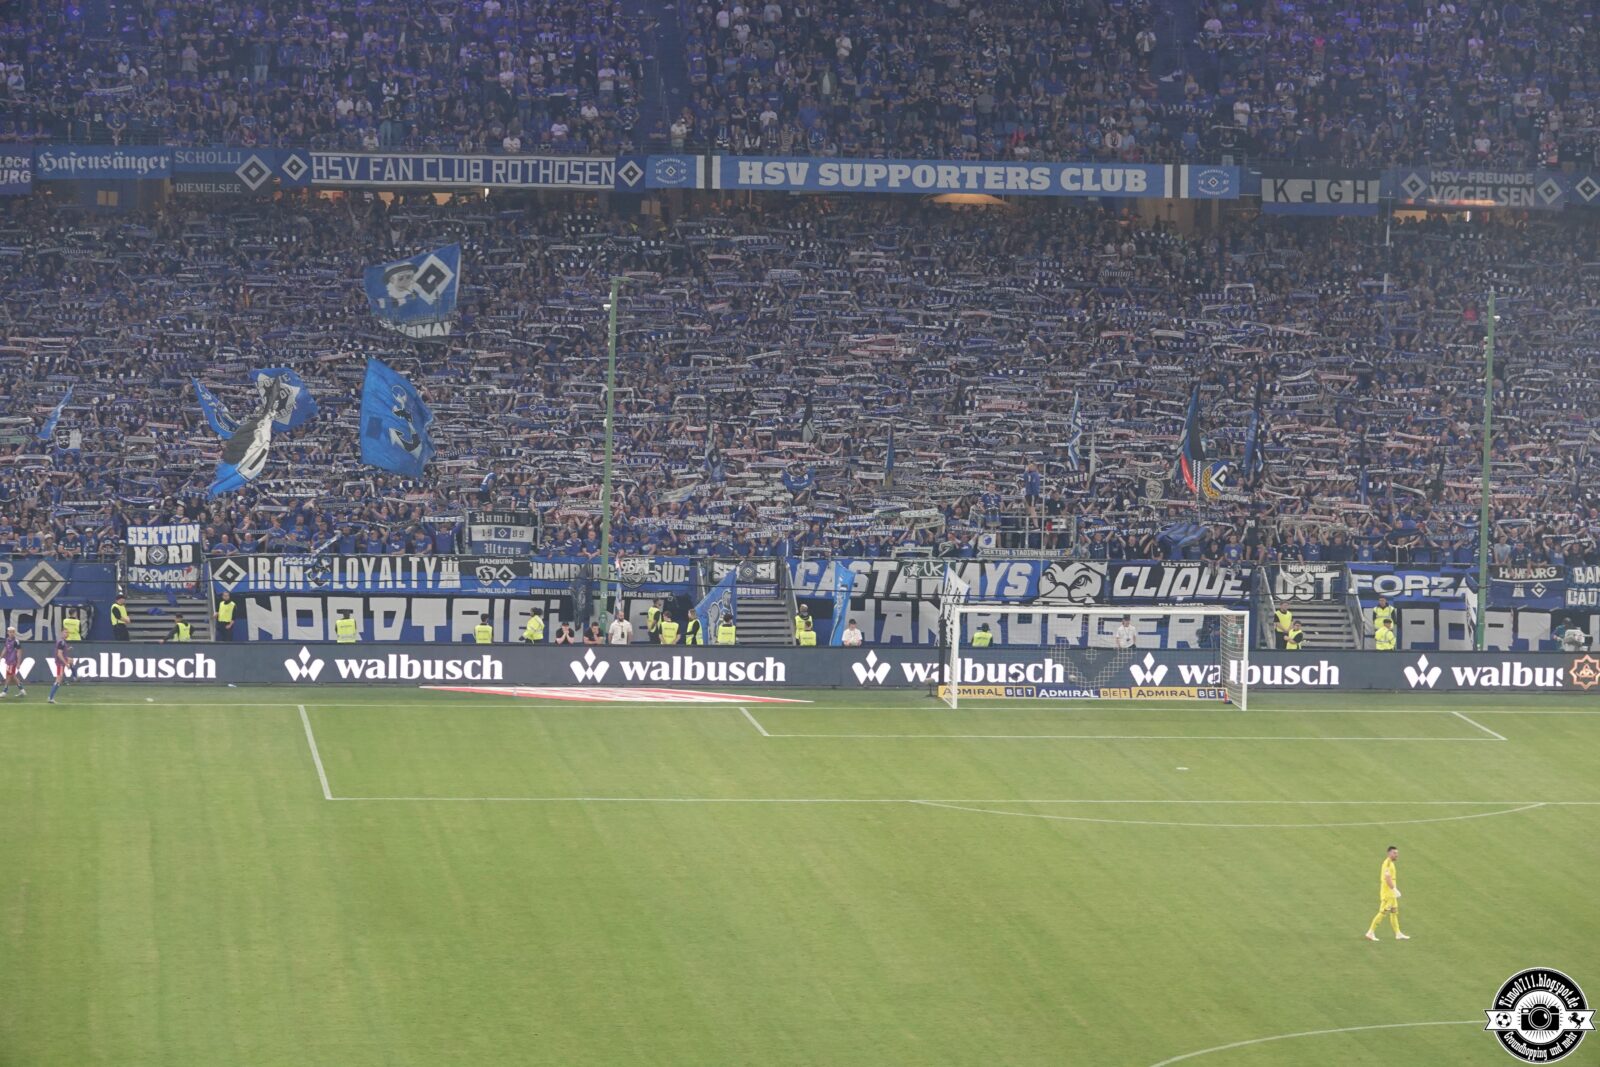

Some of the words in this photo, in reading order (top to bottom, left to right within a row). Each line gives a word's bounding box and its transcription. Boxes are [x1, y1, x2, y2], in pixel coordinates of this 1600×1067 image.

[38, 151, 170, 175] Hafensänger
[175, 151, 241, 164] SCHOLLI
[311, 156, 358, 179] HSV
[369, 157, 414, 181] FAN
[422, 158, 484, 183] CLUB
[492, 159, 615, 185] ROTHOSEN
[738, 161, 810, 185] HSV
[818, 163, 1050, 191] SUPPORTERS
[1060, 167, 1147, 192] CLUB
[1430, 171, 1534, 185] HSV-FREUNDE
[176, 183, 241, 193] DIEMELSEE
[128, 524, 200, 545] SEKTION
[479, 557, 514, 565] HAMBURG
[484, 543, 521, 555] Ultras
[248, 557, 304, 590] IRON
[333, 557, 437, 589] LOYALTY
[1288, 564, 1327, 573] HAMBURG
[46, 653, 217, 679] walbusch
[334, 653, 504, 681] walbusch
[620, 655, 787, 682] walbusch
[901, 658, 1065, 684] walbusch
[1178, 660, 1340, 687] walbusch
[943, 686, 1002, 698] ADMIRAL
[1006, 687, 1034, 697] BET
[1038, 688, 1099, 698] ADMIRAL
[1102, 688, 1128, 697] BET
[1136, 687, 1196, 698] ADMIRAL
[1198, 688, 1225, 698] BET
